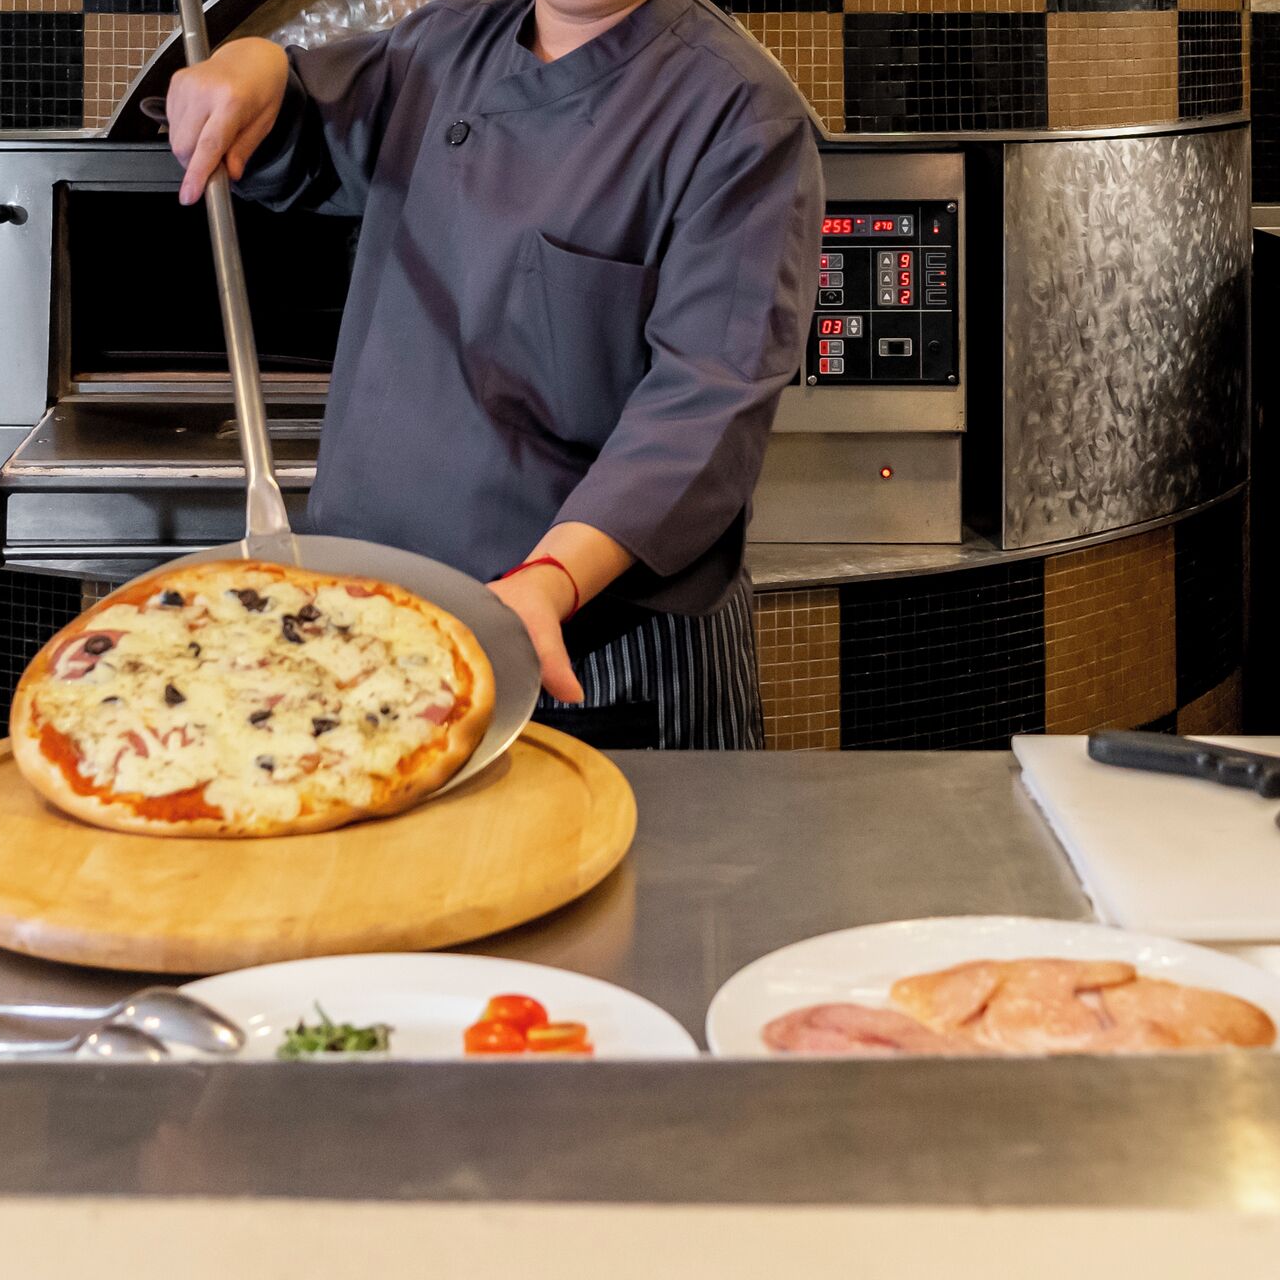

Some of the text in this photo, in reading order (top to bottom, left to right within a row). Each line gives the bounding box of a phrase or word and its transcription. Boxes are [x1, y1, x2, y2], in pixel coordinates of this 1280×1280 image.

[822, 218, 893, 234] 255 270
[900, 254, 910, 268] 9
[901, 272, 910, 286] 5
[900, 290, 910, 304] 2
[821, 320, 842, 334] 03
